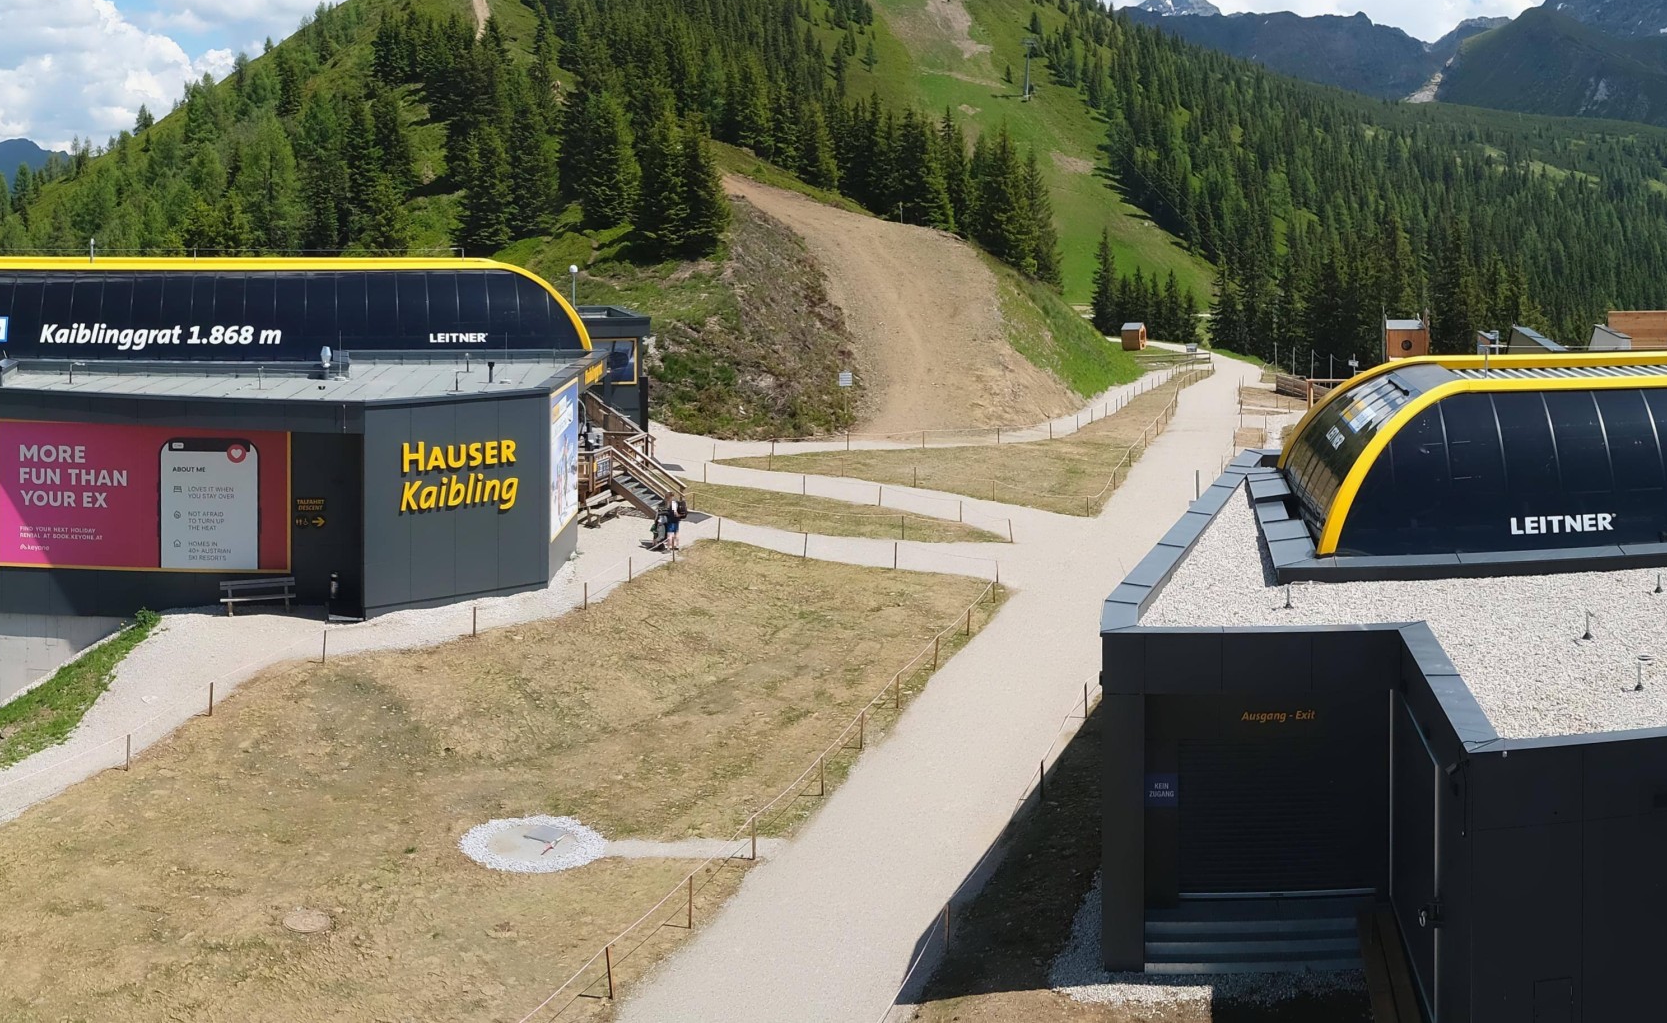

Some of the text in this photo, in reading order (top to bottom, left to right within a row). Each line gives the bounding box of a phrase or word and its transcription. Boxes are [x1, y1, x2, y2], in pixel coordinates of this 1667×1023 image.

[39, 323, 282, 350] Kaiblinggrat 1.868 m
[429, 332, 487, 343] LEITNER
[19, 444, 86, 463] MORE
[402, 439, 517, 473] HAUSER
[19, 467, 128, 486] FUN THAN
[20, 490, 108, 508] YOUR EX
[400, 473, 519, 512] Kaibling
[1510, 513, 1614, 535] LEITNER
[1241, 711, 1287, 723] Ausgang
[1295, 710, 1316, 720] Exit
[1149, 790, 1175, 798] ZUGANG
[1154, 782, 1169, 790] KEIN
